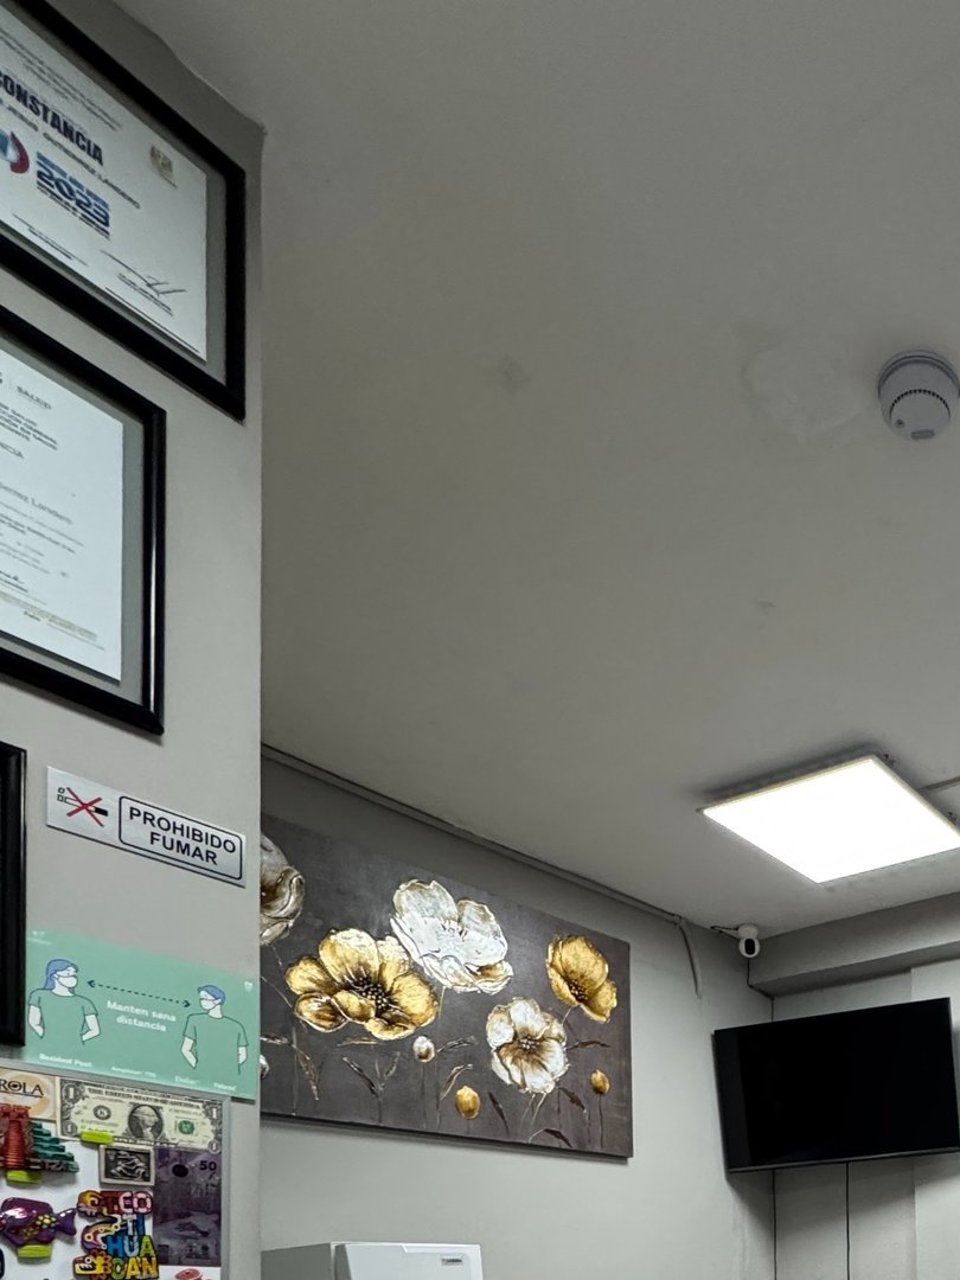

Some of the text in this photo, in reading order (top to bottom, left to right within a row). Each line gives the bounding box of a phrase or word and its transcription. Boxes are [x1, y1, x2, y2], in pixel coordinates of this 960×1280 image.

[36, 160, 110, 228] 2023
[129, 806, 236, 853] PROHIBIDO
[150, 832, 217, 865] FUMAR
[116, 1015, 167, 1032] distancia
[199, 1161, 217, 1171] 50
